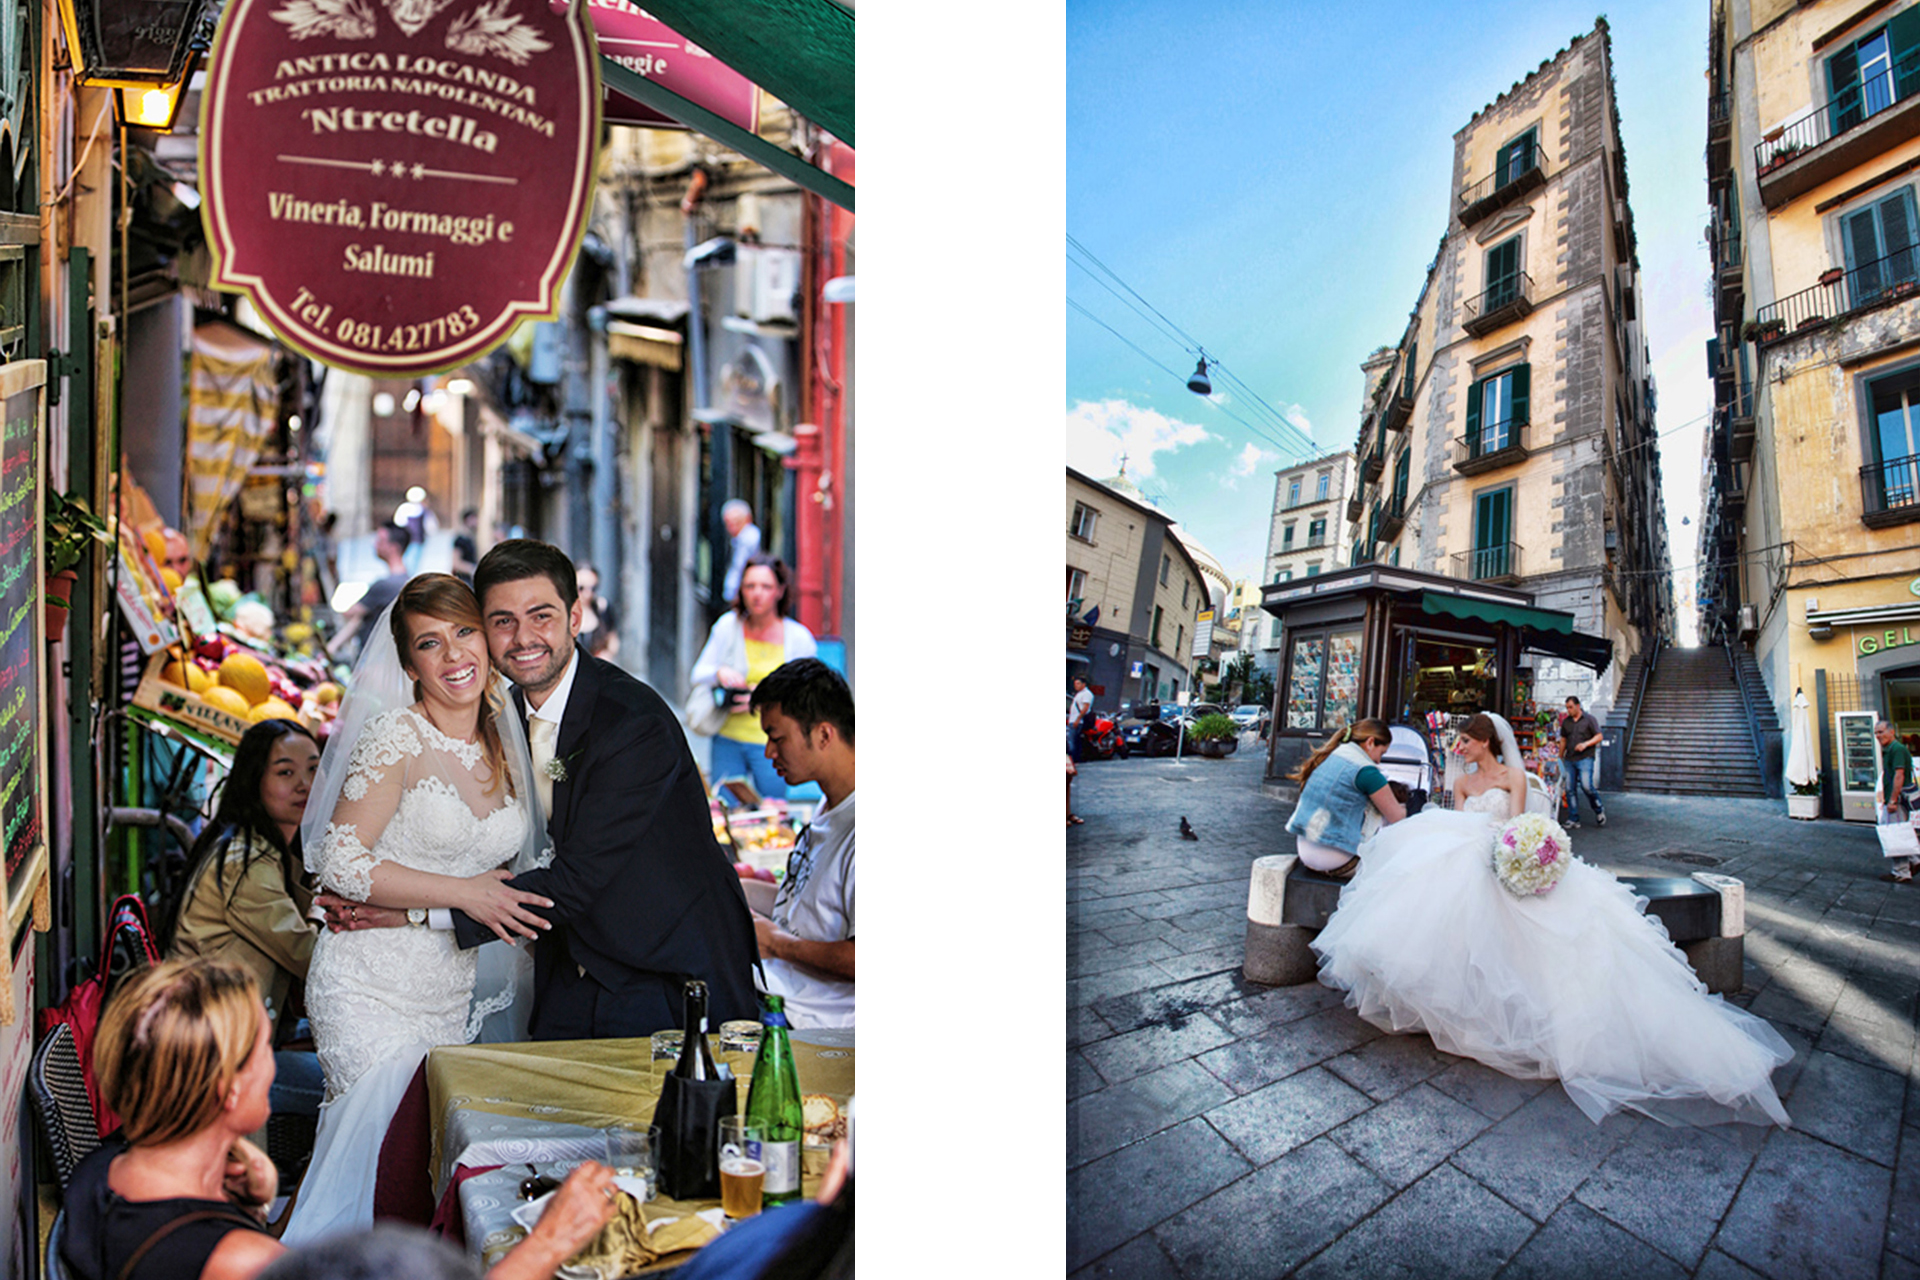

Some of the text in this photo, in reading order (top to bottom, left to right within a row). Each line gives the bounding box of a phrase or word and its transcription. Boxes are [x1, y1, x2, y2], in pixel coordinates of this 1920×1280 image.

[274, 52, 536, 106] ANTICA LOCANDA
[604, 53, 653, 76] aggi
[247, 76, 555, 138] TRATTORIA NAPOLENTANA
[268, 192, 514, 246] Vineria, Formaggi e
[343, 243, 435, 279] Salumi
[289, 286, 480, 351] Tel. 081.427783
[1859, 627, 1915, 654] GEL
[186, 704, 248, 735] VILLAN
